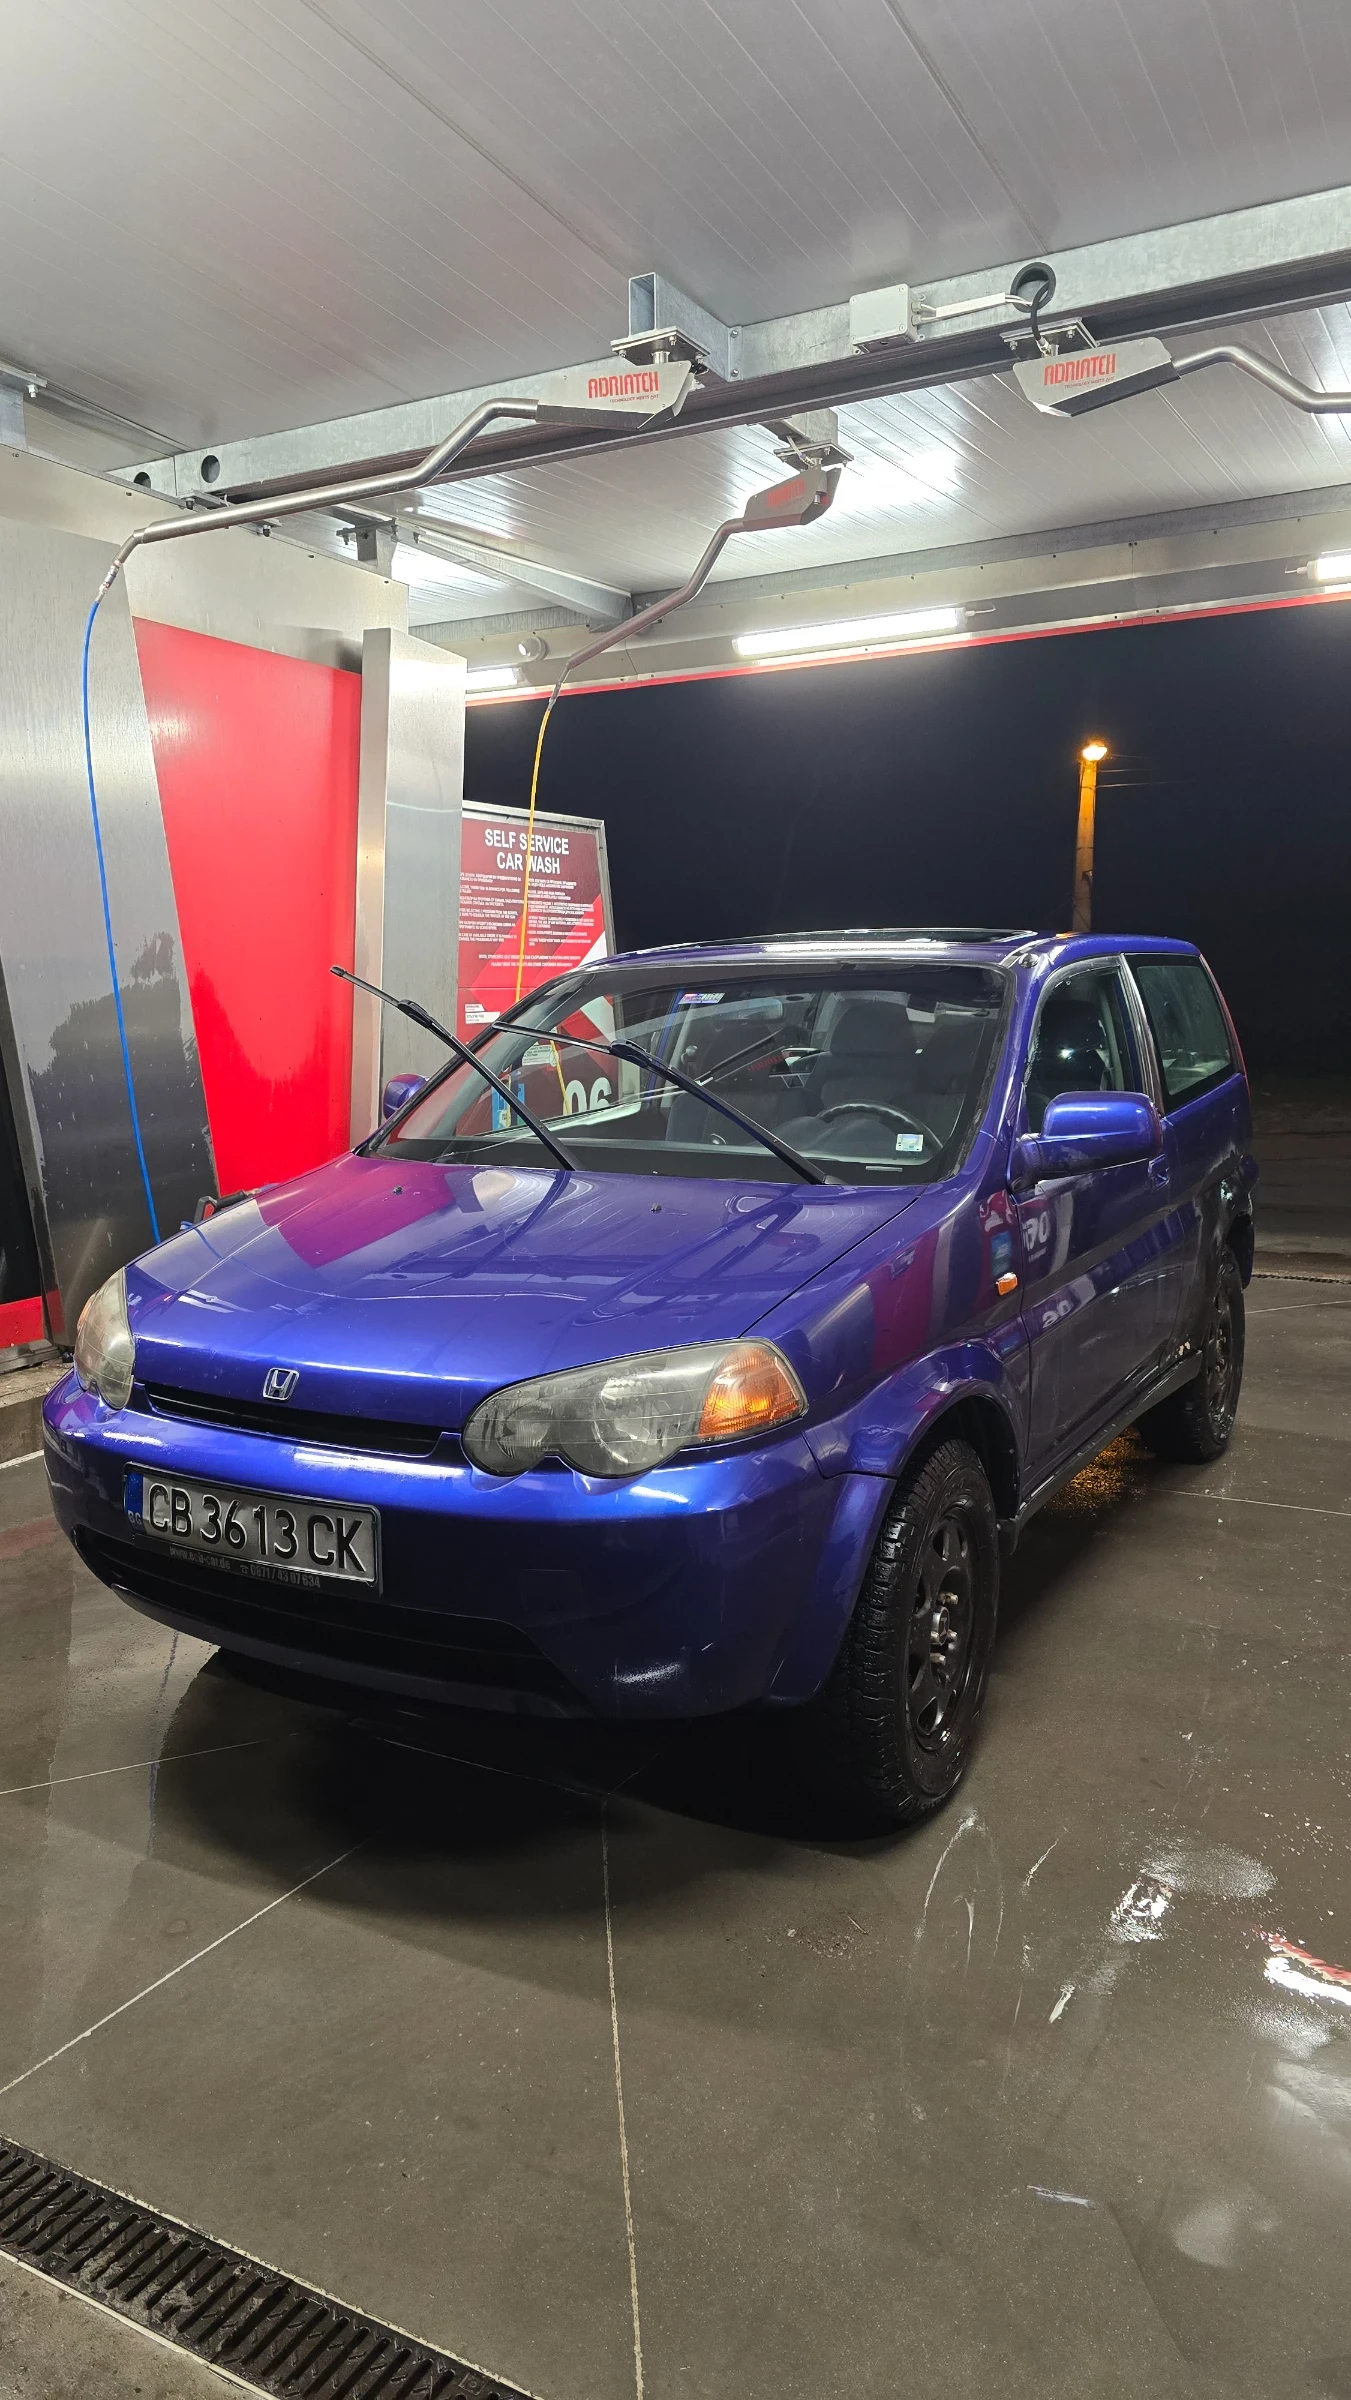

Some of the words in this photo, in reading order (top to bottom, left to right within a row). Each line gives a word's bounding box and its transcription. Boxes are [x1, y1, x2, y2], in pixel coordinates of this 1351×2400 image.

[485, 829, 517, 849] SELF
[519, 832, 570, 855] SERVICE
[496, 851, 524, 871] CAR
[525, 854, 561, 875] WASH
[128, 1510, 142, 1525] BG
[149, 1483, 193, 1537] CB
[200, 1494, 298, 1559] 3613
[307, 1514, 366, 1572] CK
[302, 1574, 321, 1588] 634
